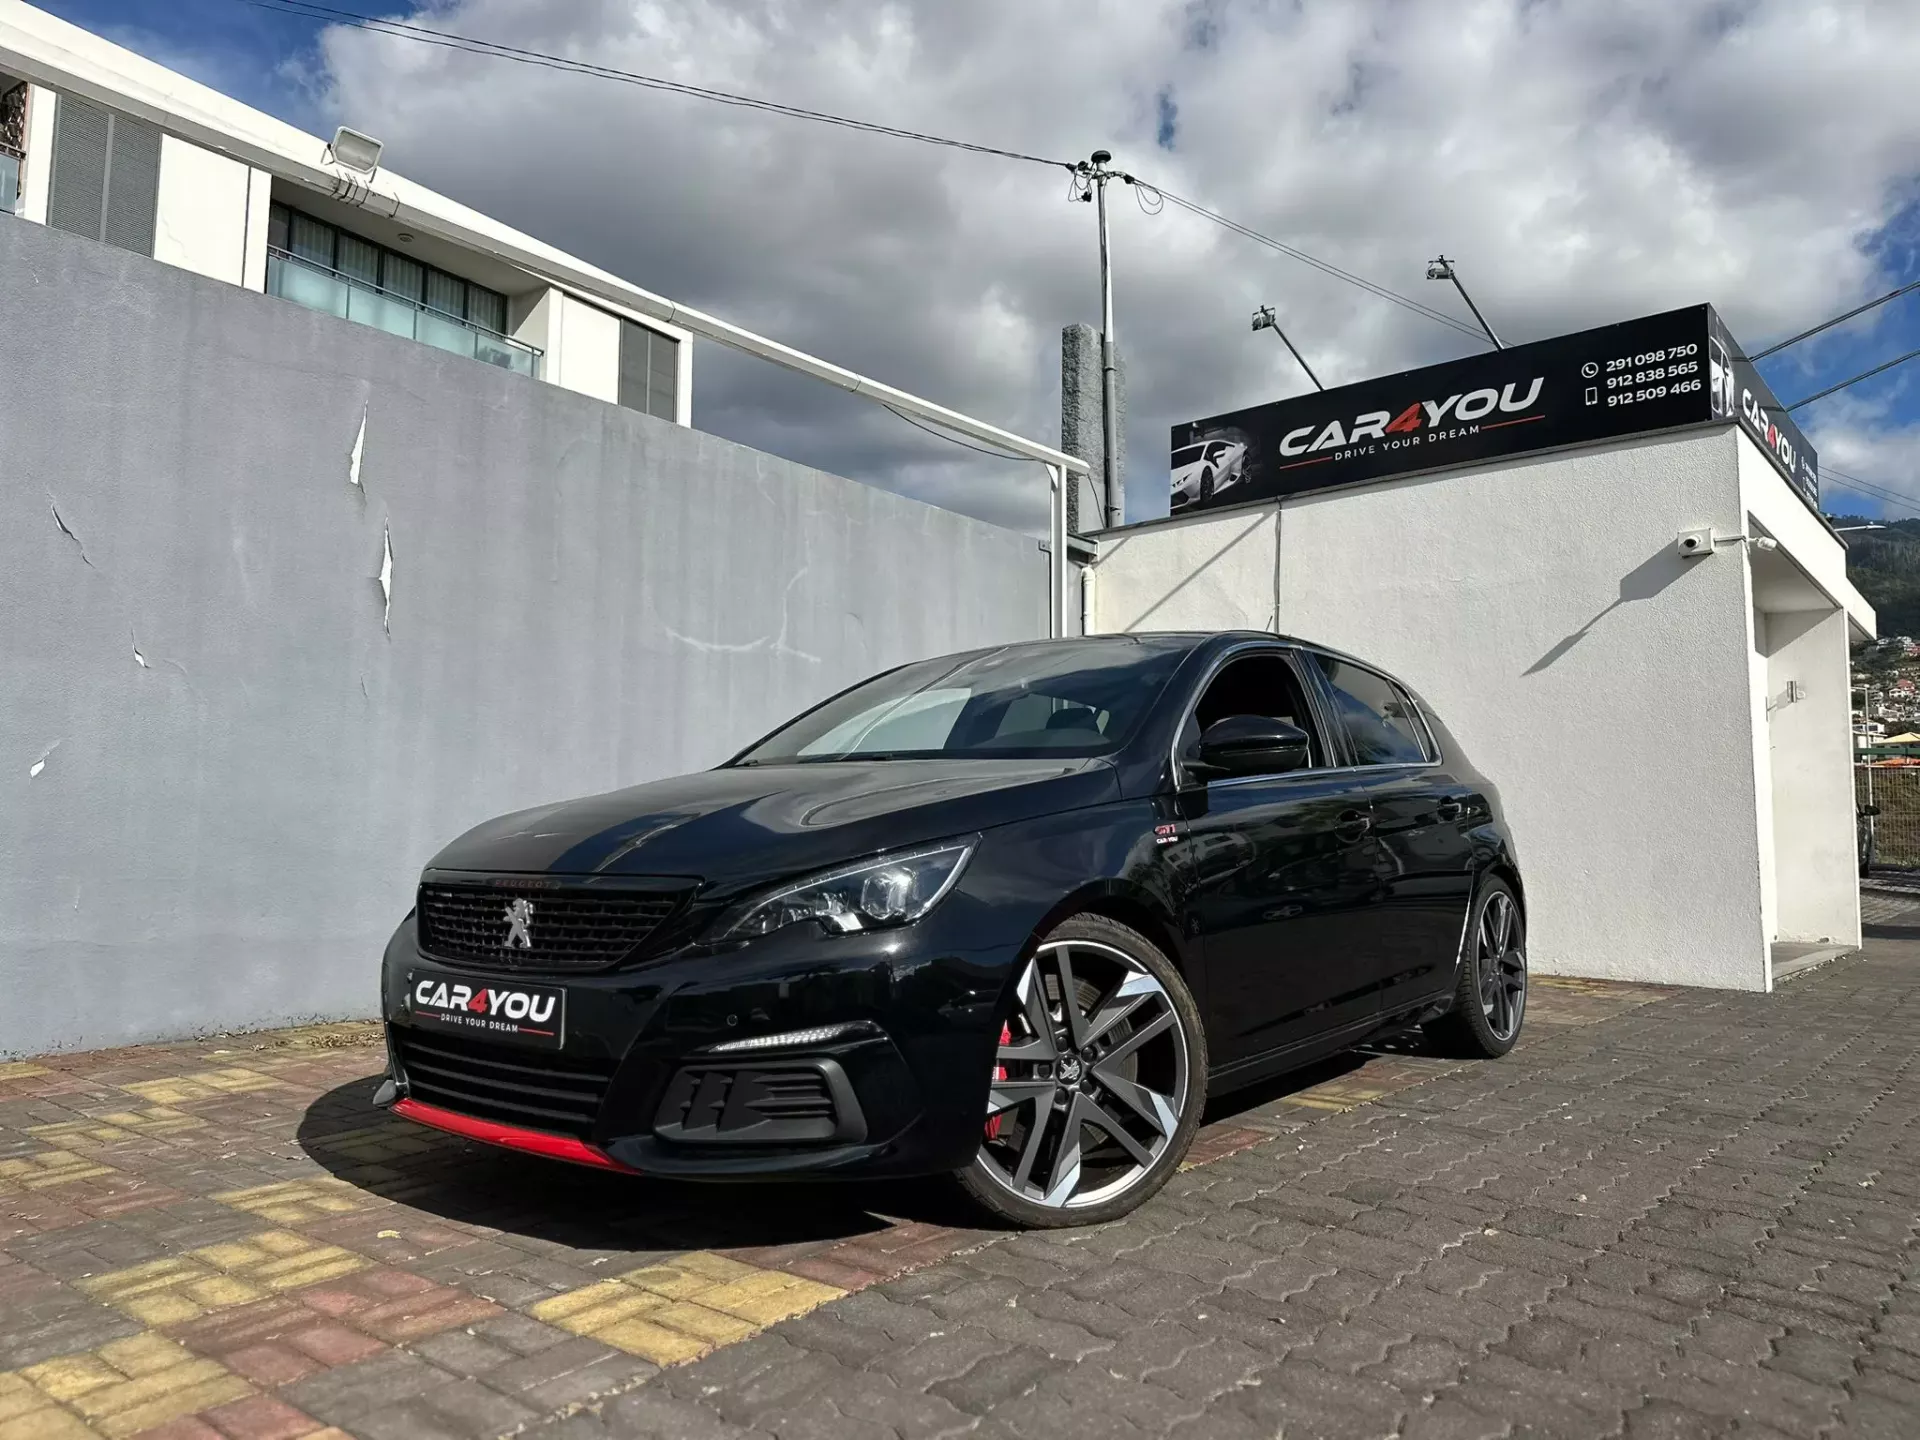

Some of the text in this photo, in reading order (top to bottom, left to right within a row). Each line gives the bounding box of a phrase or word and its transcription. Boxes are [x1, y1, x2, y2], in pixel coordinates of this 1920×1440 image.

[1606, 343, 1698, 372] 291 098 750
[1606, 361, 1698, 388] 912 838 565
[1607, 379, 1701, 406] 912 509 466
[1279, 377, 1544, 457] CAR4YOU
[1742, 388, 1796, 473] CAR4YOU
[1334, 424, 1480, 461] DRIVE YOUR DREAM
[416, 980, 556, 1022] CAR4YOU
[440, 1014, 518, 1032] DRIVE YOUR DREAM
